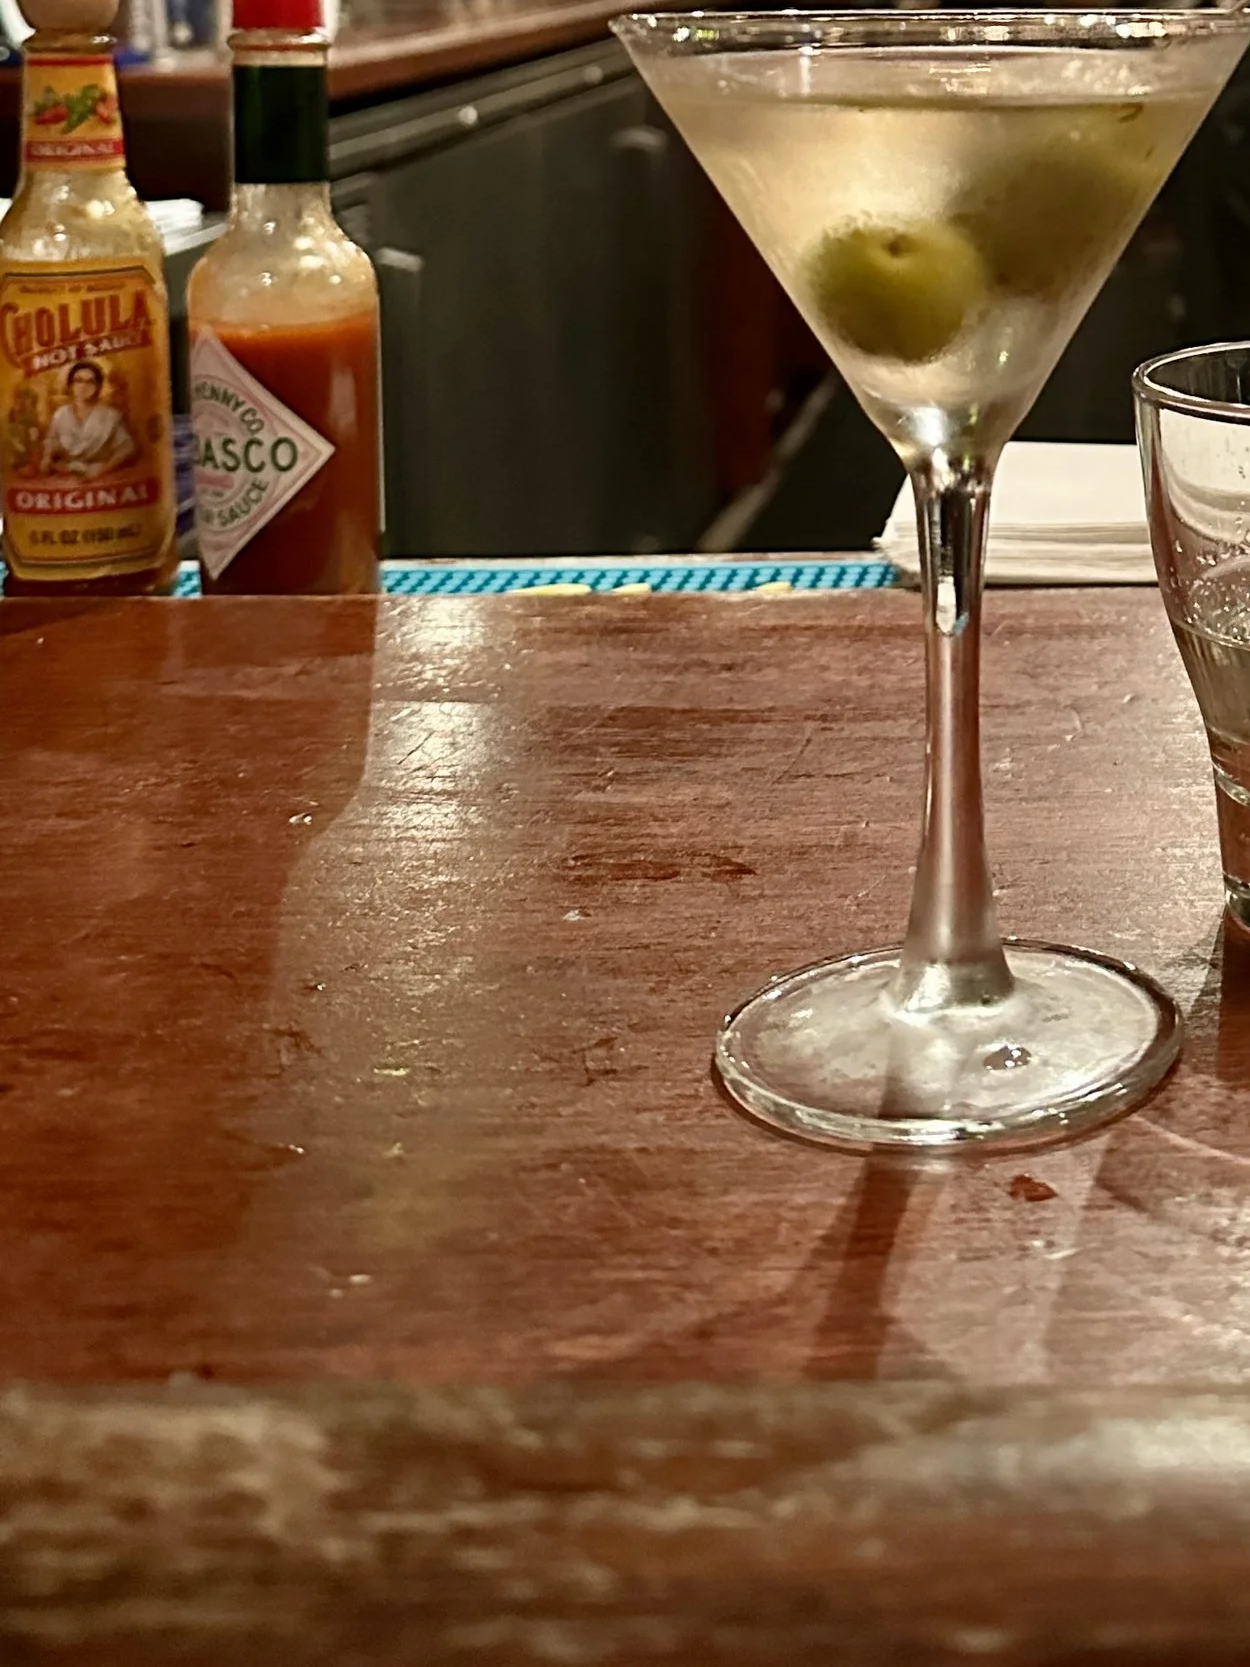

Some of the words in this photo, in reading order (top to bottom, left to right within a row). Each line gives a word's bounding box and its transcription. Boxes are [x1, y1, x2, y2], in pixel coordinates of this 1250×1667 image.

[0, 291, 151, 369] CHOLULA
[32, 343, 78, 370] HOT
[15, 485, 149, 511] ORIGINAL
[217, 477, 270, 527] SAUCE
